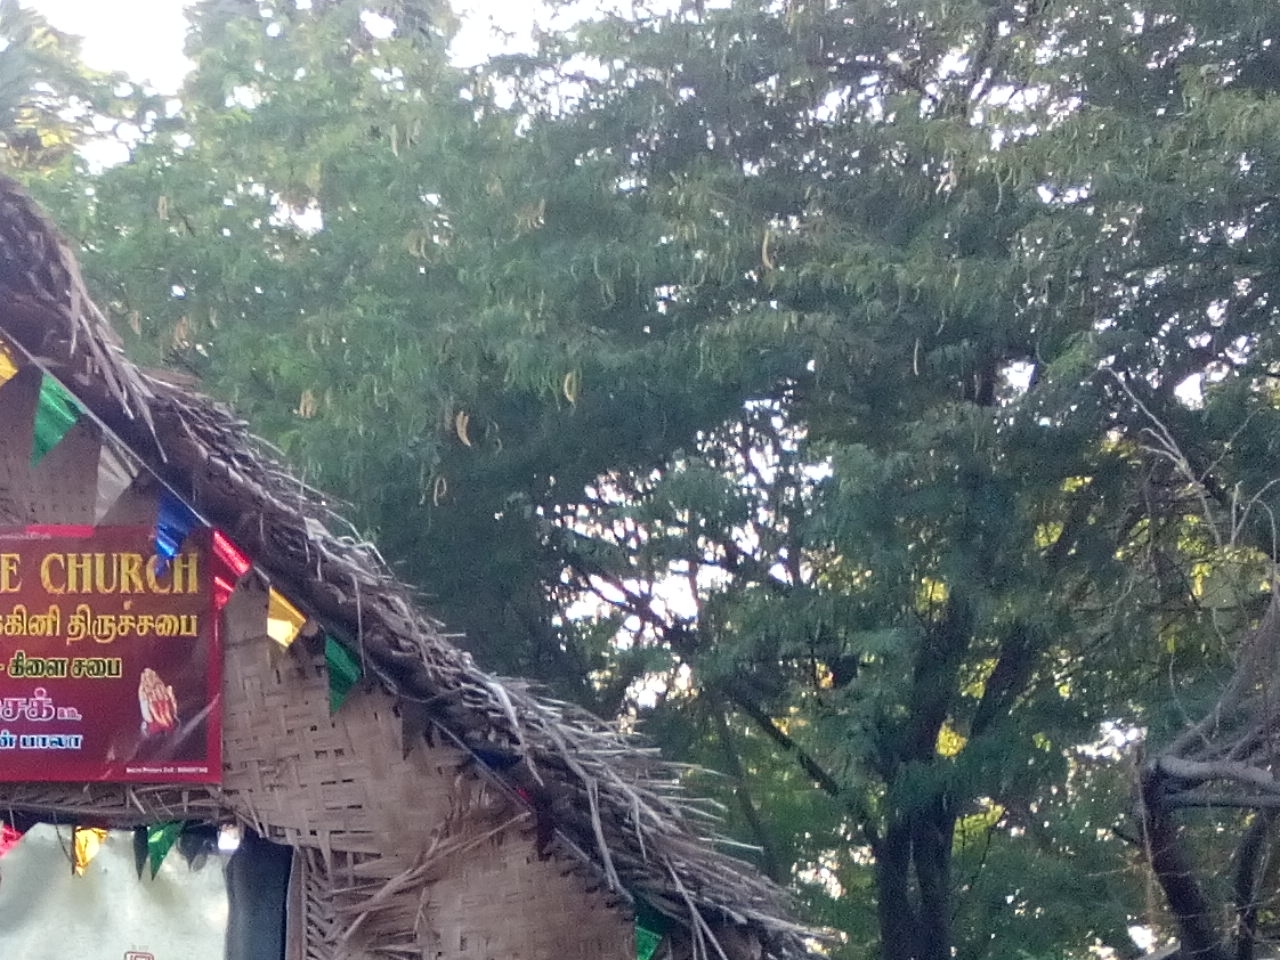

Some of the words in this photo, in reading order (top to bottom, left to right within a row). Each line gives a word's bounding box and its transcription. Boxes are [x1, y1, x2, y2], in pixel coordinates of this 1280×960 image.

[40, 552, 199, 594] CHURCH
[66, 600, 200, 646] திருச்சபை
[71, 657, 123, 678] சபை
